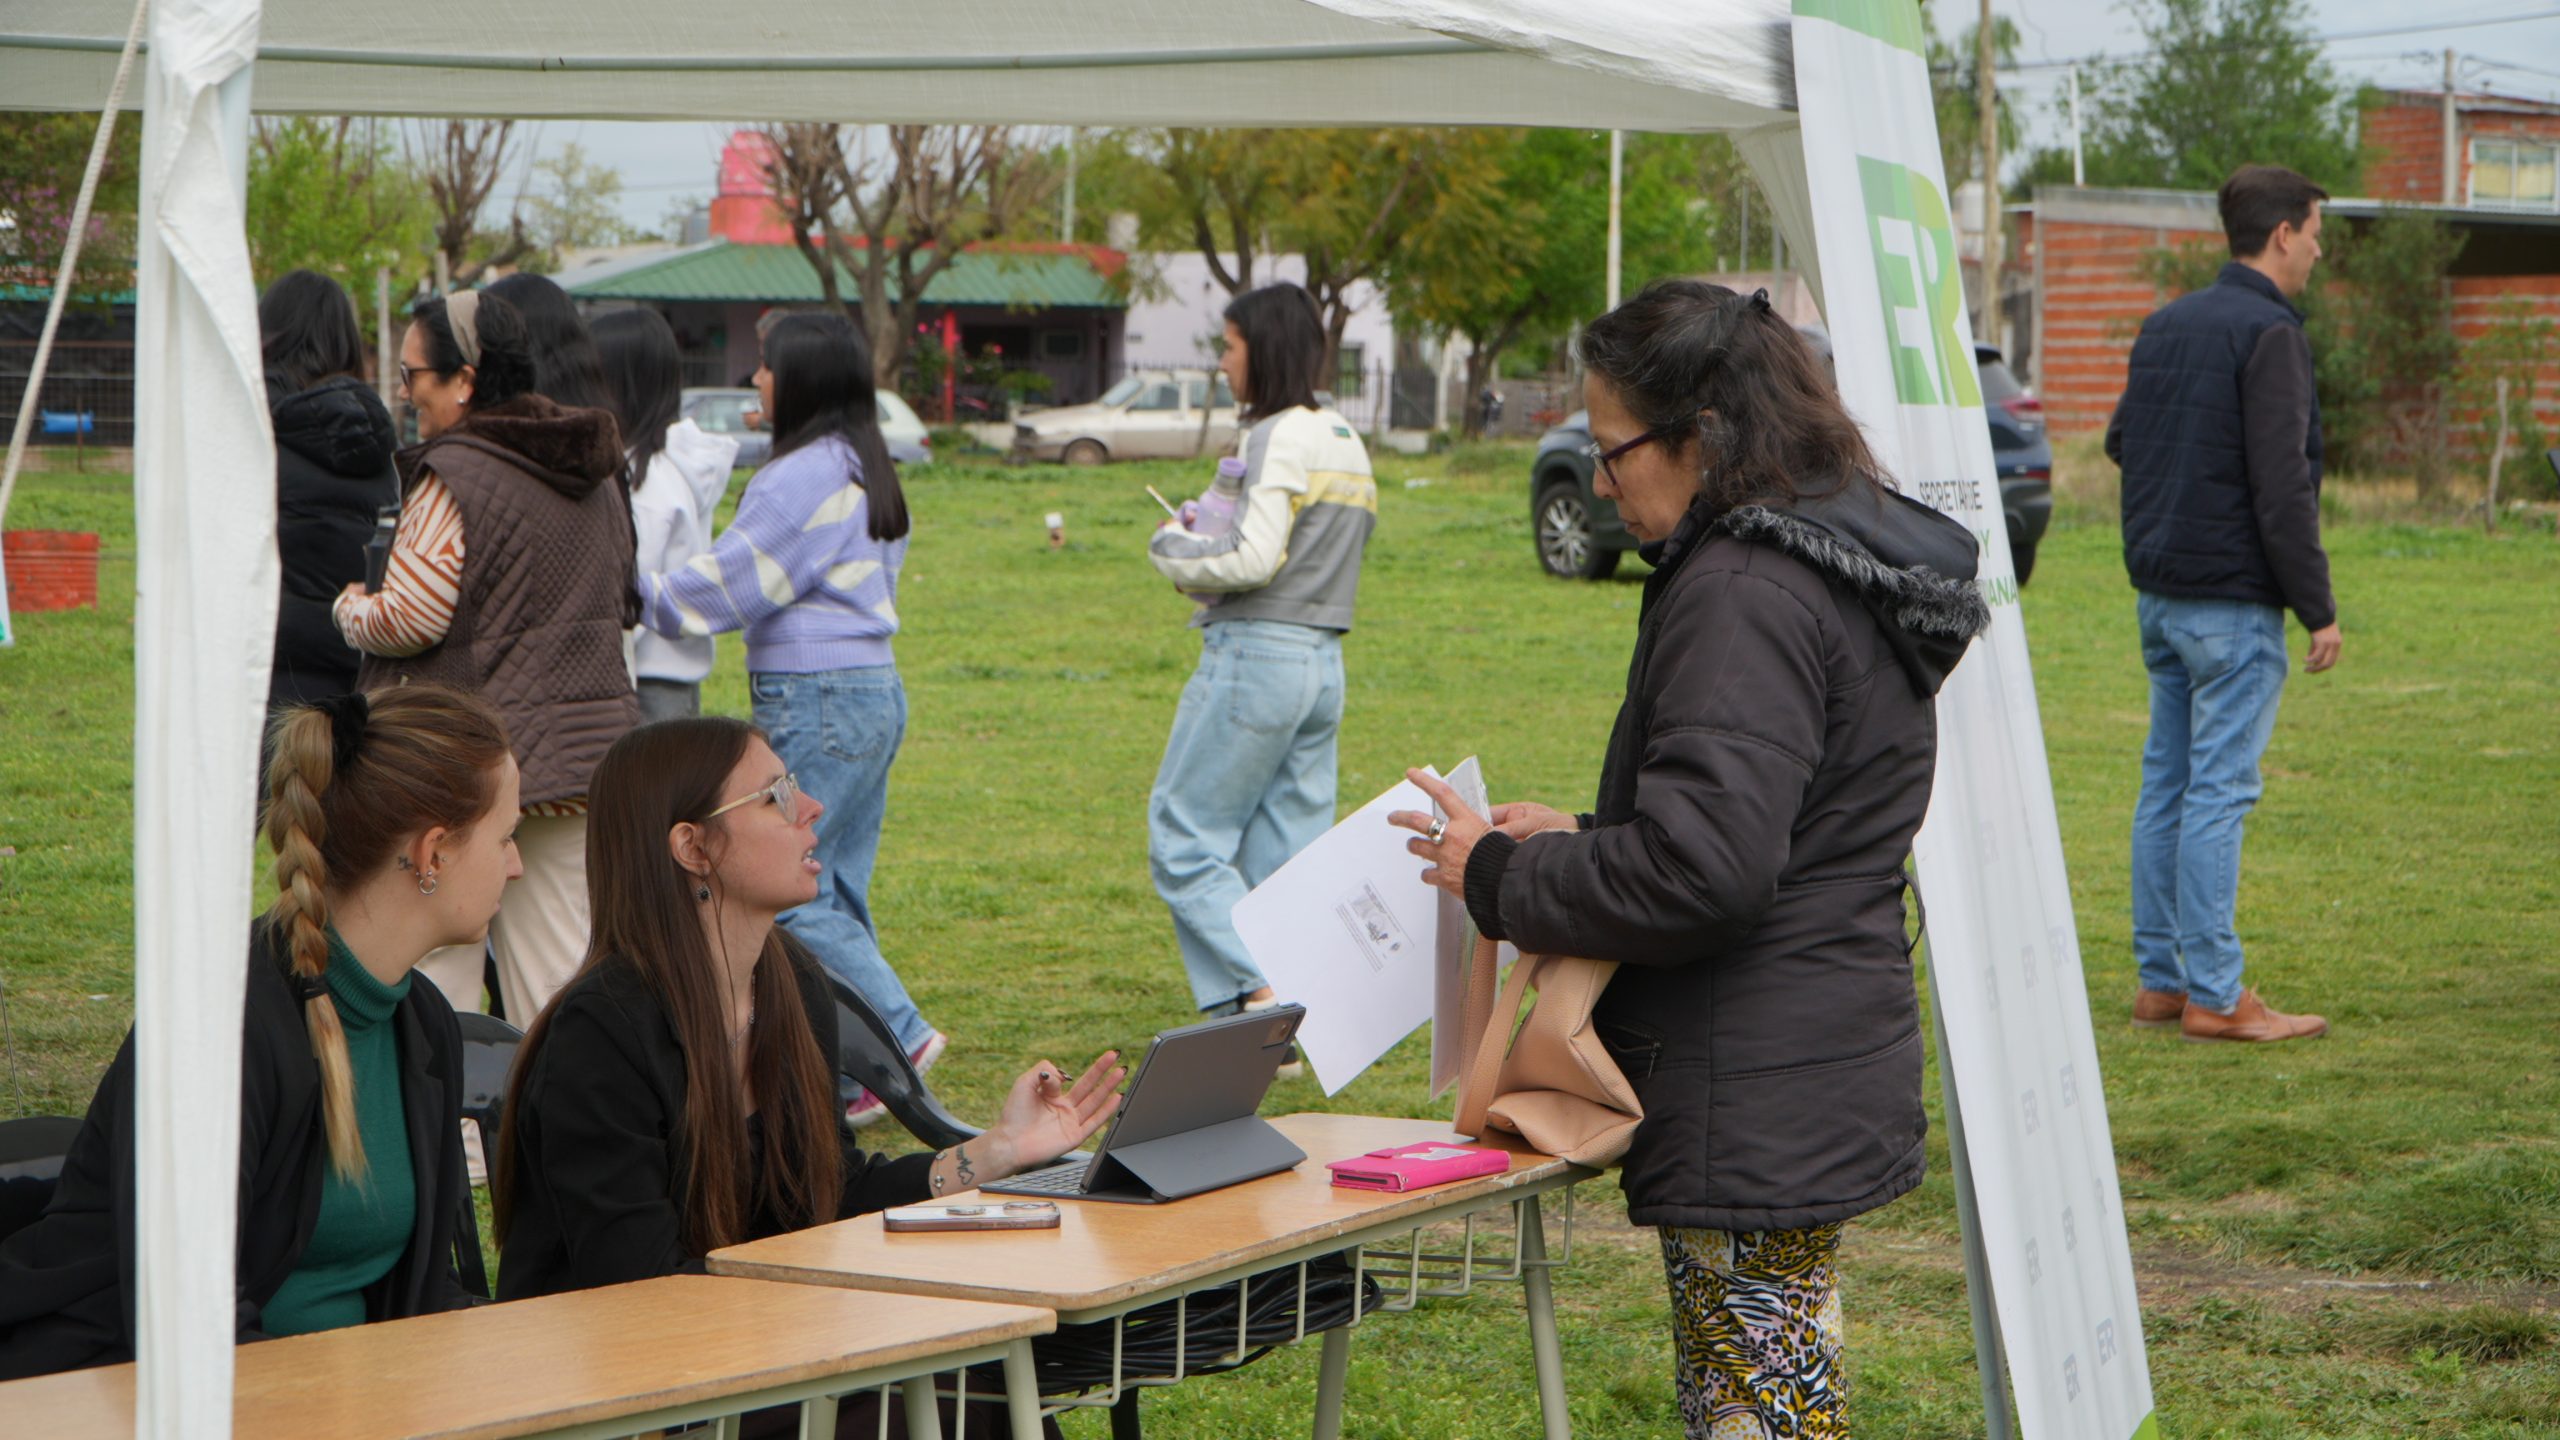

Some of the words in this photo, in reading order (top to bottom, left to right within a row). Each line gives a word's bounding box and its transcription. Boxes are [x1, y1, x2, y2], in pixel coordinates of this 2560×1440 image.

[1855, 154, 1983, 407] ER
[2096, 1317, 2117, 1367] ER
[2063, 1353, 2081, 1403] ER
